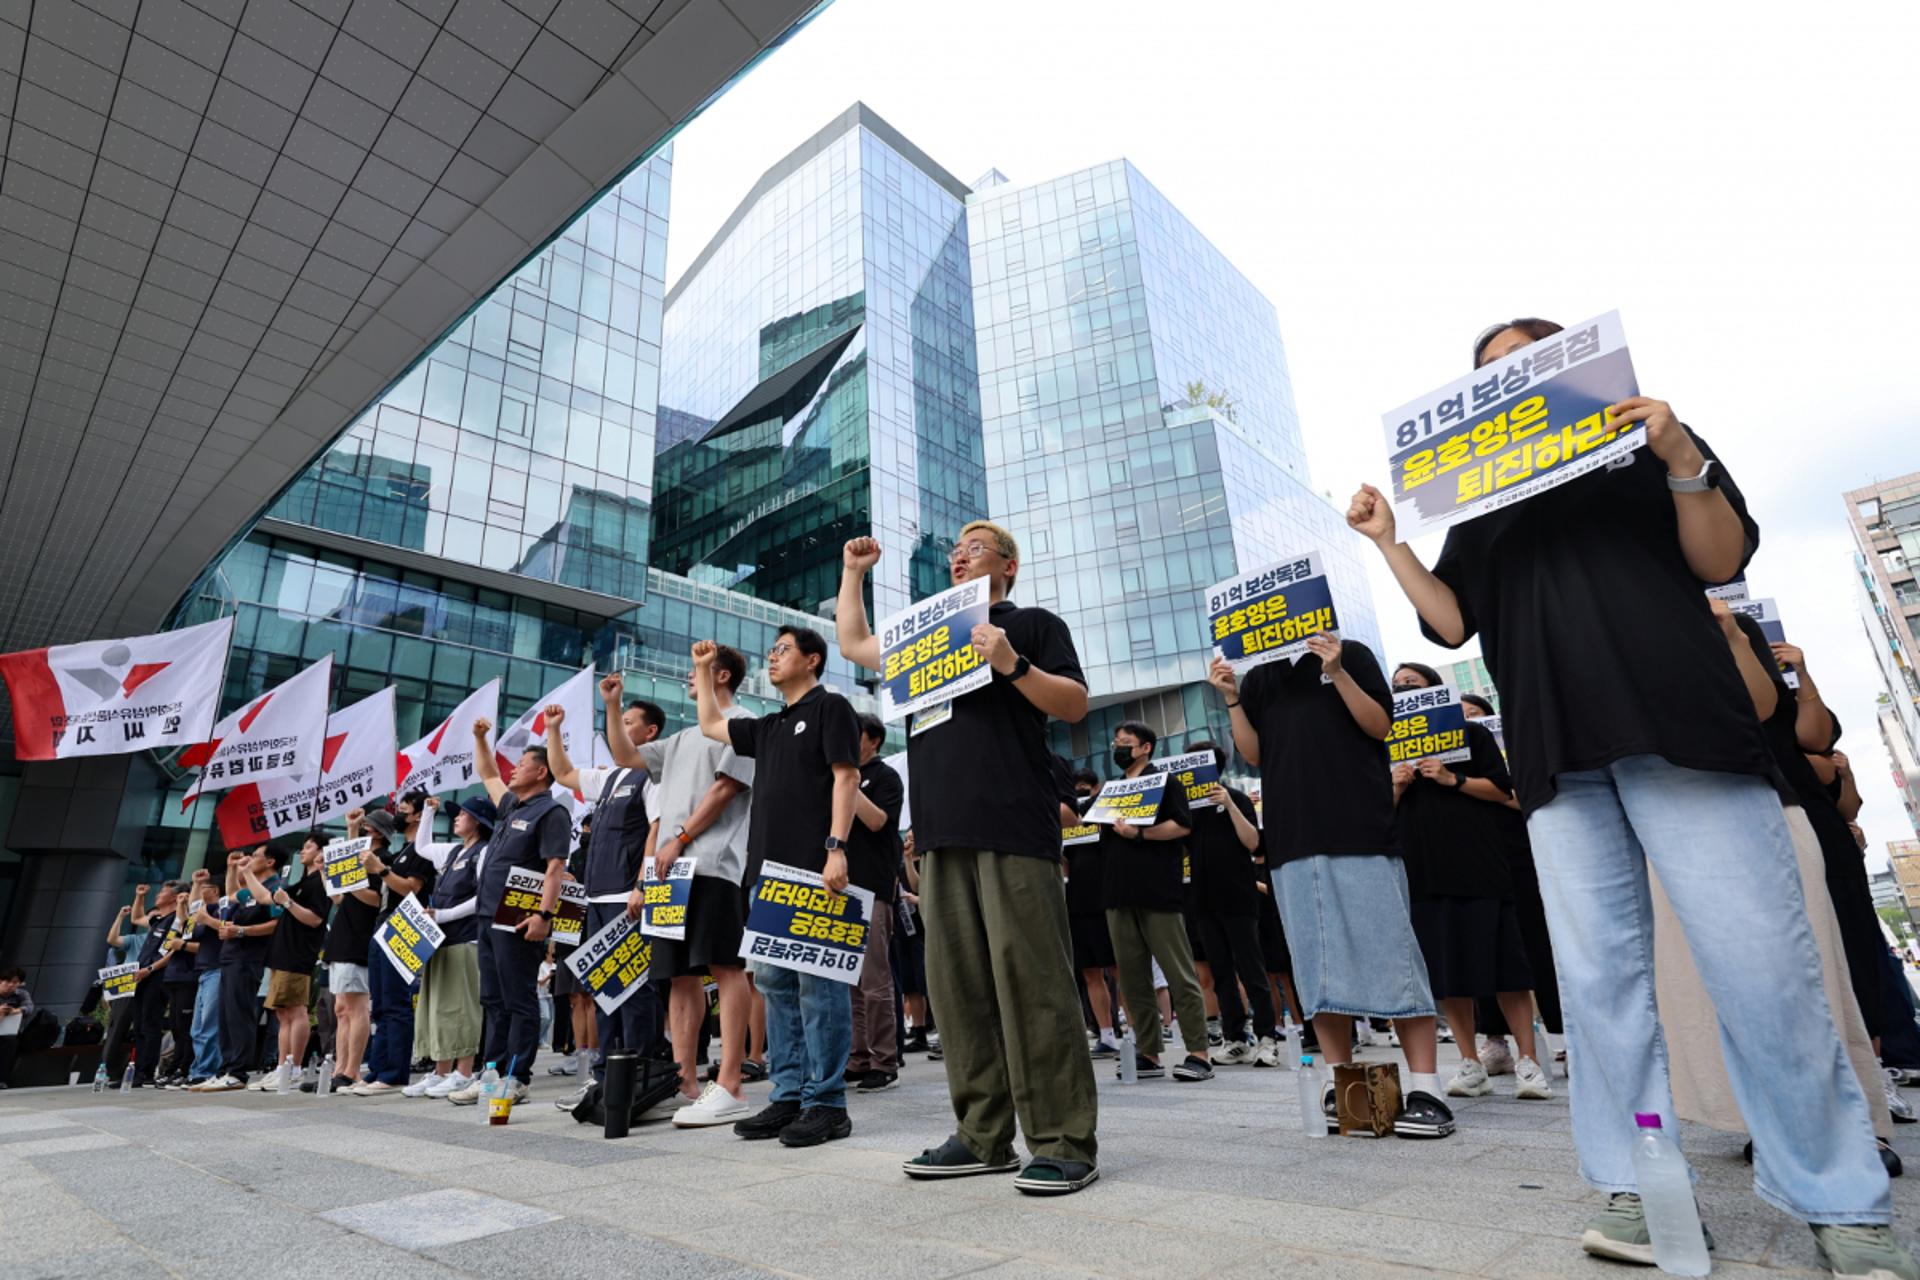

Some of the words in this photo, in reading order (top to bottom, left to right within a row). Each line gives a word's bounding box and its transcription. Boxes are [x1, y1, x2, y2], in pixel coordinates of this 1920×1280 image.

[1396, 392, 1464, 448] 81억
[1472, 324, 1601, 413] 보상독점
[1402, 395, 1549, 491] 윤호영은
[1455, 405, 1633, 504] 퇴진하라
[1211, 584, 1242, 612] 81억
[1246, 558, 1312, 597] 보상독점
[884, 616, 914, 649] 81억
[918, 584, 978, 630] 보상독점
[1215, 595, 1287, 640] 윤호영은
[1241, 607, 1332, 655] 퇴진하라!
[884, 625, 949, 681] 윤호영은
[909, 643, 985, 697] 퇴진하라
[1389, 729, 1465, 762] 퇴진하라!
[504, 890, 562, 914] 공동교
[758, 880, 849, 916] 퇴진하라!
[751, 936, 821, 965] 보상독점
[789, 911, 865, 947] 윤호영은
[576, 943, 607, 973] 81억
[587, 932, 644, 991] 윤호영은
[820, 949, 859, 972] 81억
